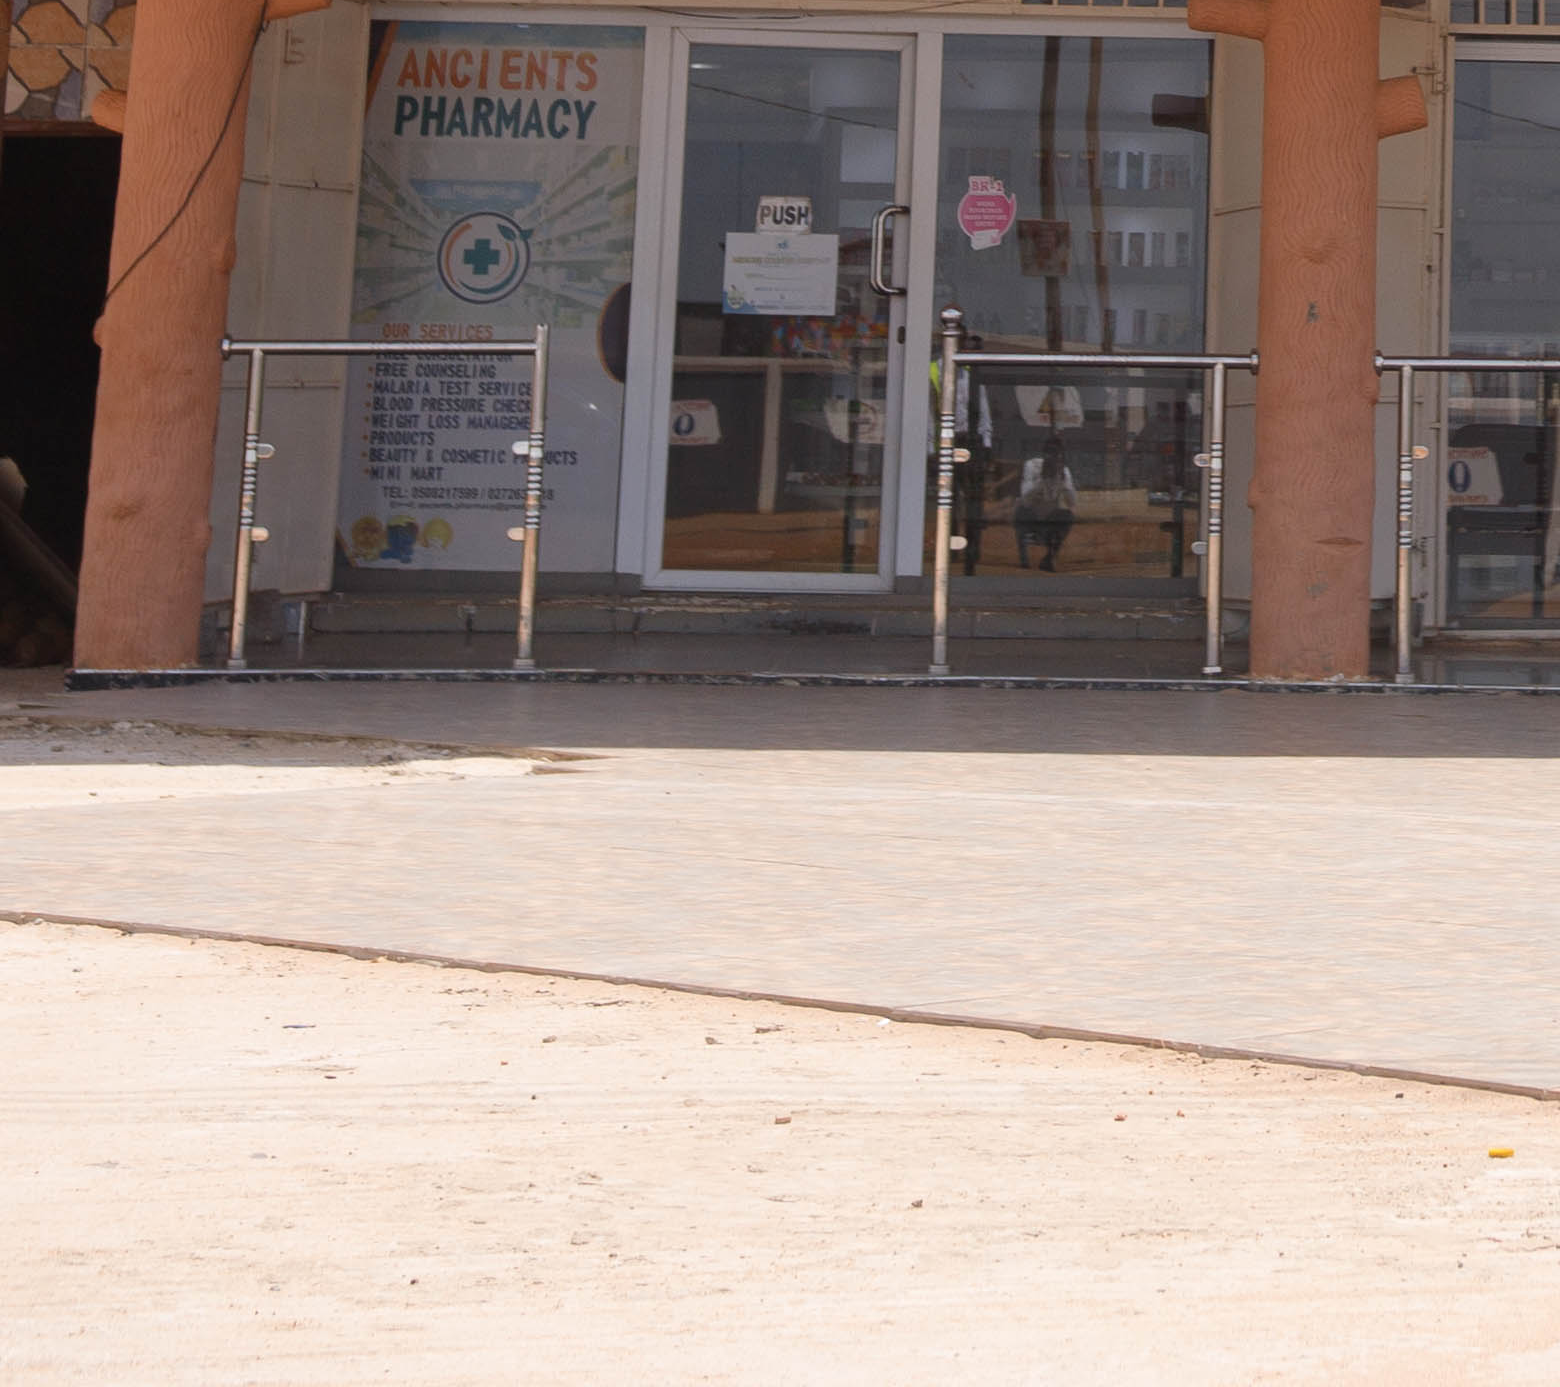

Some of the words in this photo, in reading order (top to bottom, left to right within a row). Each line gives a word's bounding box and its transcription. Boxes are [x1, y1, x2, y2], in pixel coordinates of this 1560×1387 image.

[396, 47, 598, 92] ANCIENTS
[393, 94, 597, 140] PHARMACY
[759, 204, 809, 225] PUSH
[382, 322, 410, 338] OUR
[419, 324, 494, 340] SERVICES
[375, 363, 409, 377] FREE
[415, 364, 497, 379] COUNSELING
[373, 380, 431, 395] MALARIA
[440, 381, 472, 396] TEST
[372, 396, 414, 412] BLOOD
[420, 397, 486, 413] PRESSURE
[371, 414, 420, 428] WEIGHT
[428, 415, 460, 429] LOSS
[369, 431, 435, 446] PRODUCTS
[368, 448, 418, 463] BEAUTY
[441, 450, 507, 465] COSMETIC
[512, 450, 578, 465] PRUCTS
[370, 466, 401, 480] MINI
[410, 467, 444, 481] MART
